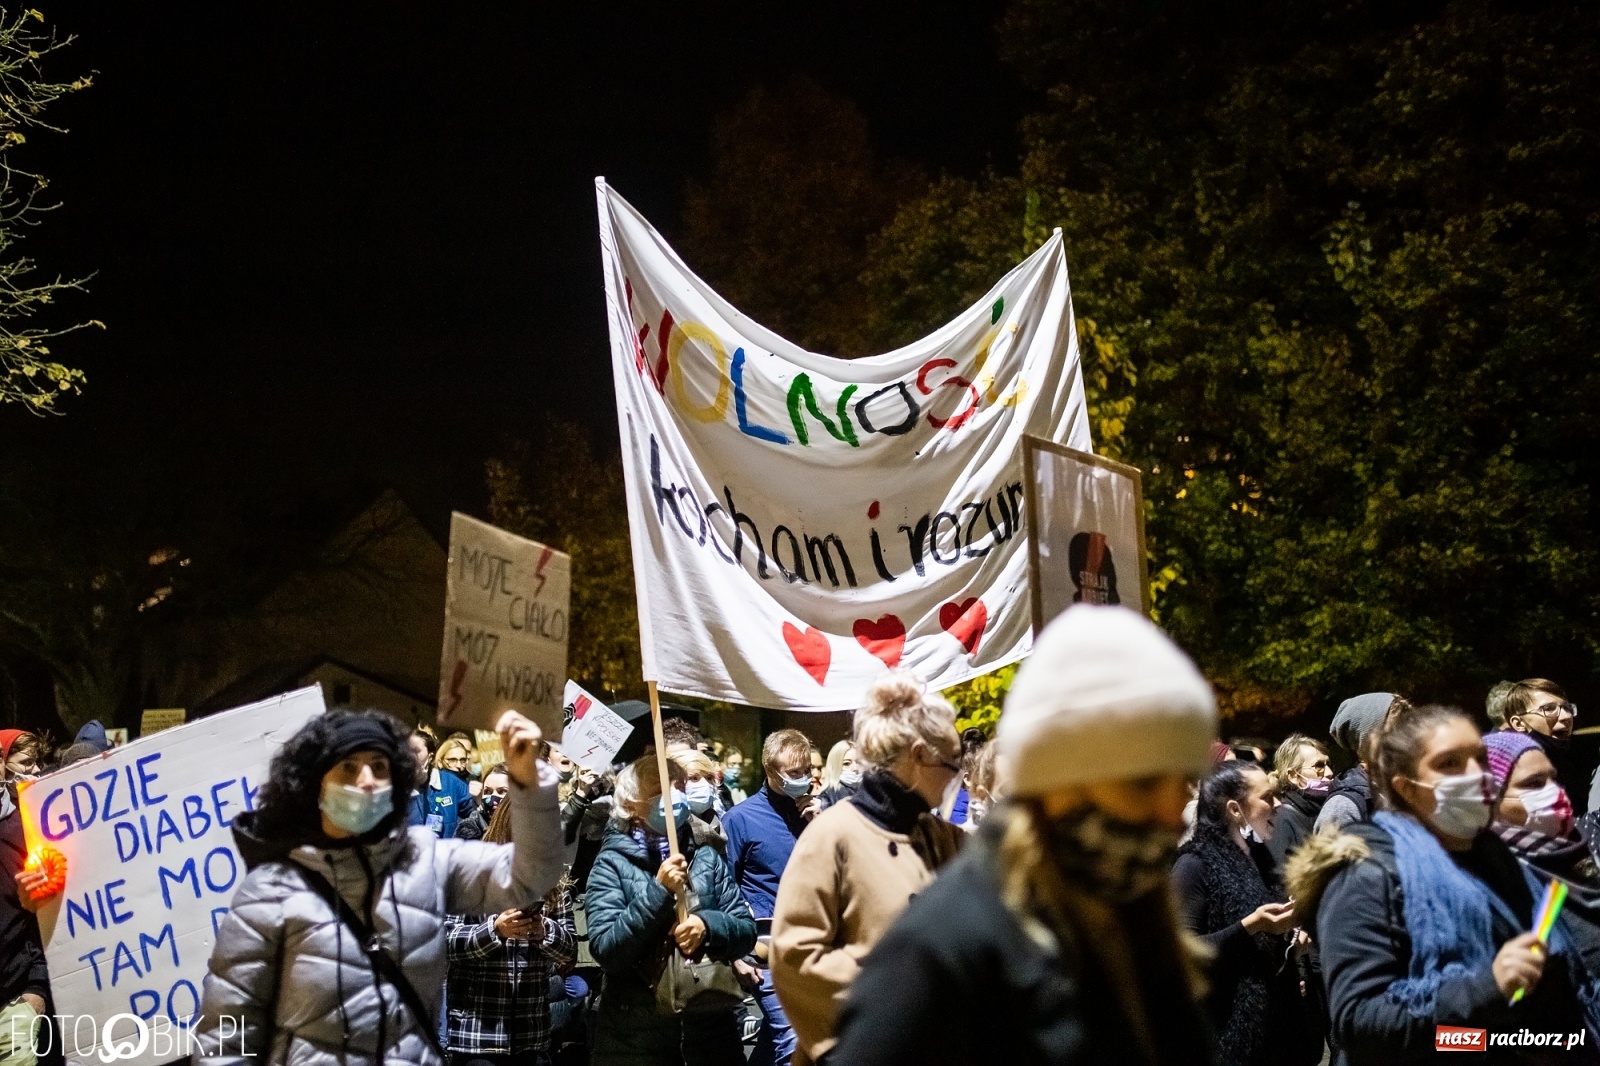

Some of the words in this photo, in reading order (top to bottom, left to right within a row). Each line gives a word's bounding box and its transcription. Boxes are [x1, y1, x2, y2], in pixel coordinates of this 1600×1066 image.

[650, 432, 857, 588] kocham
[867, 500, 897, 583] i
[460, 545, 513, 605] MOJE
[40, 752, 168, 842] GDZIE
[66, 878, 134, 938] NIE
[78, 923, 180, 991] TAM
